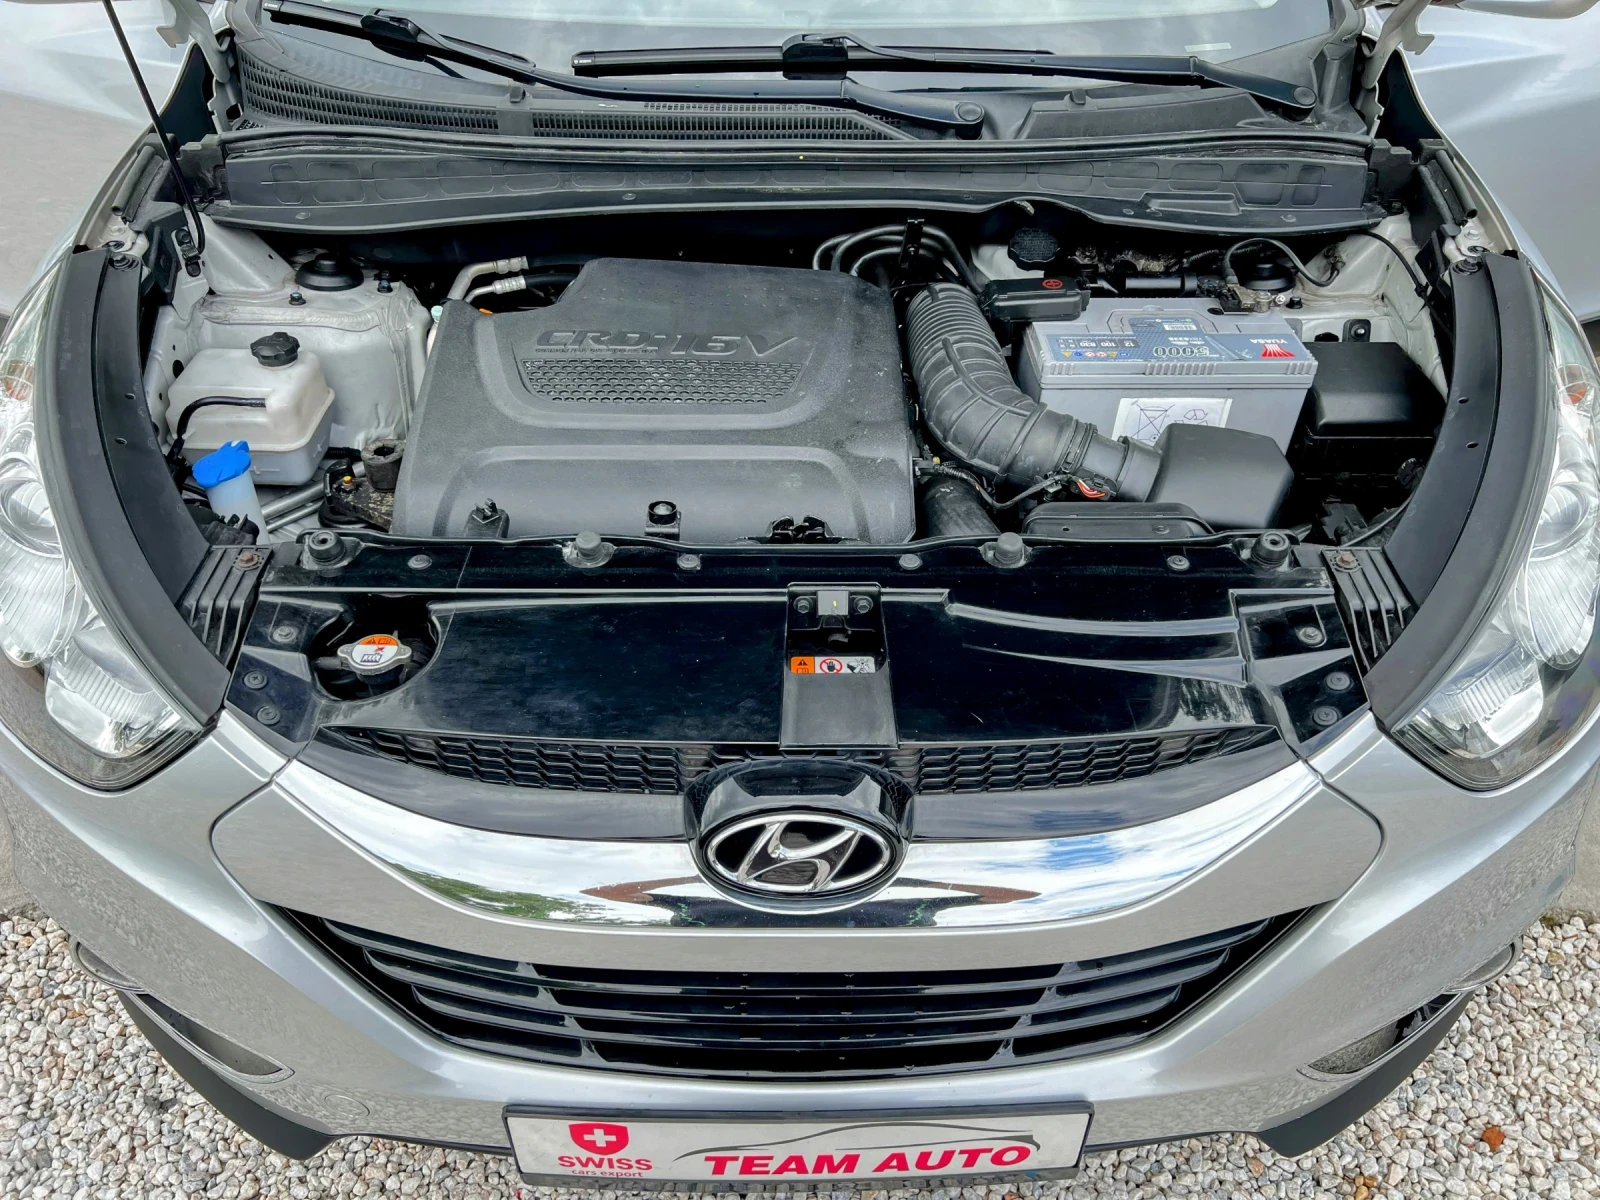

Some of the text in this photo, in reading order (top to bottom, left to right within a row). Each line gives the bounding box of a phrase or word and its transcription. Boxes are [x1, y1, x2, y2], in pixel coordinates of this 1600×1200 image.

[1153, 346, 1209, 357] 5000
[557, 1155, 653, 1171] SWISS
[704, 1145, 1031, 1175] TEAM AUTO
[600, 1169, 643, 1178] export
